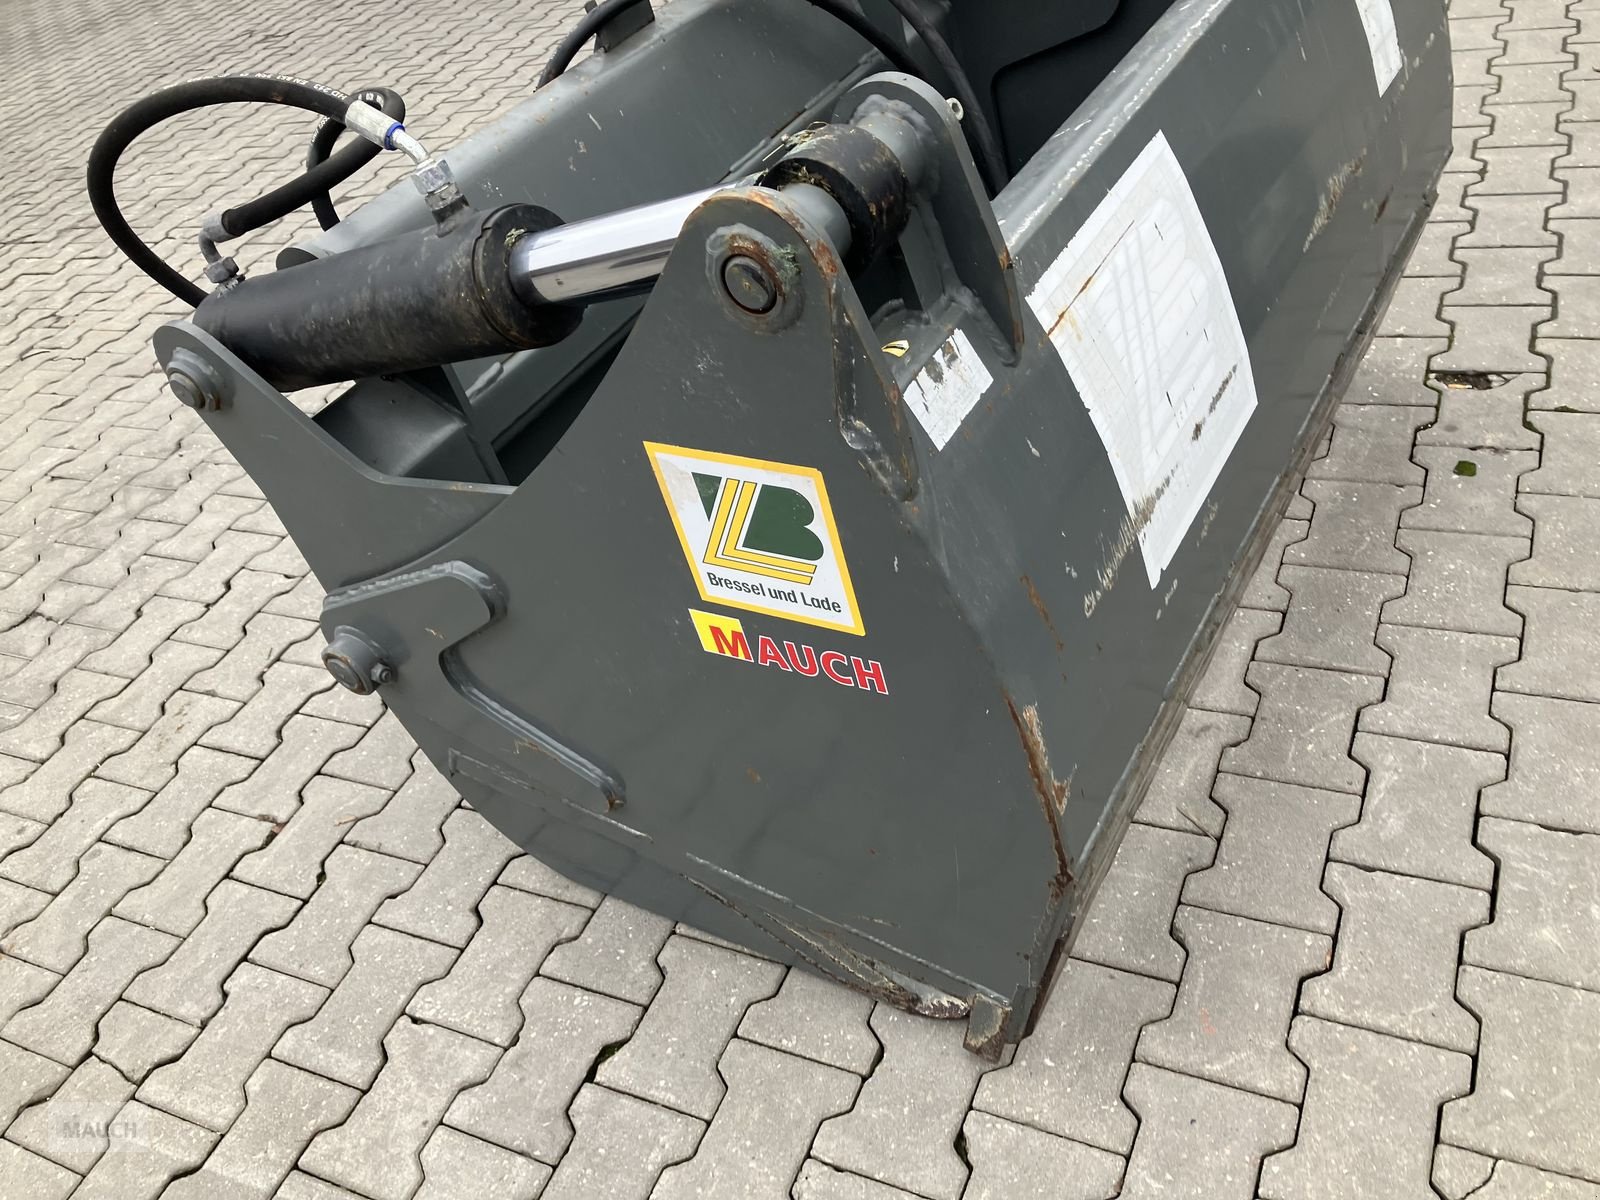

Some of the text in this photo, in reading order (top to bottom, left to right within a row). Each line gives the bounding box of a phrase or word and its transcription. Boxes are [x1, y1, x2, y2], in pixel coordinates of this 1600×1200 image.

[706, 571, 842, 613] Bressel und Lade
[708, 624, 889, 695] MAUCH
